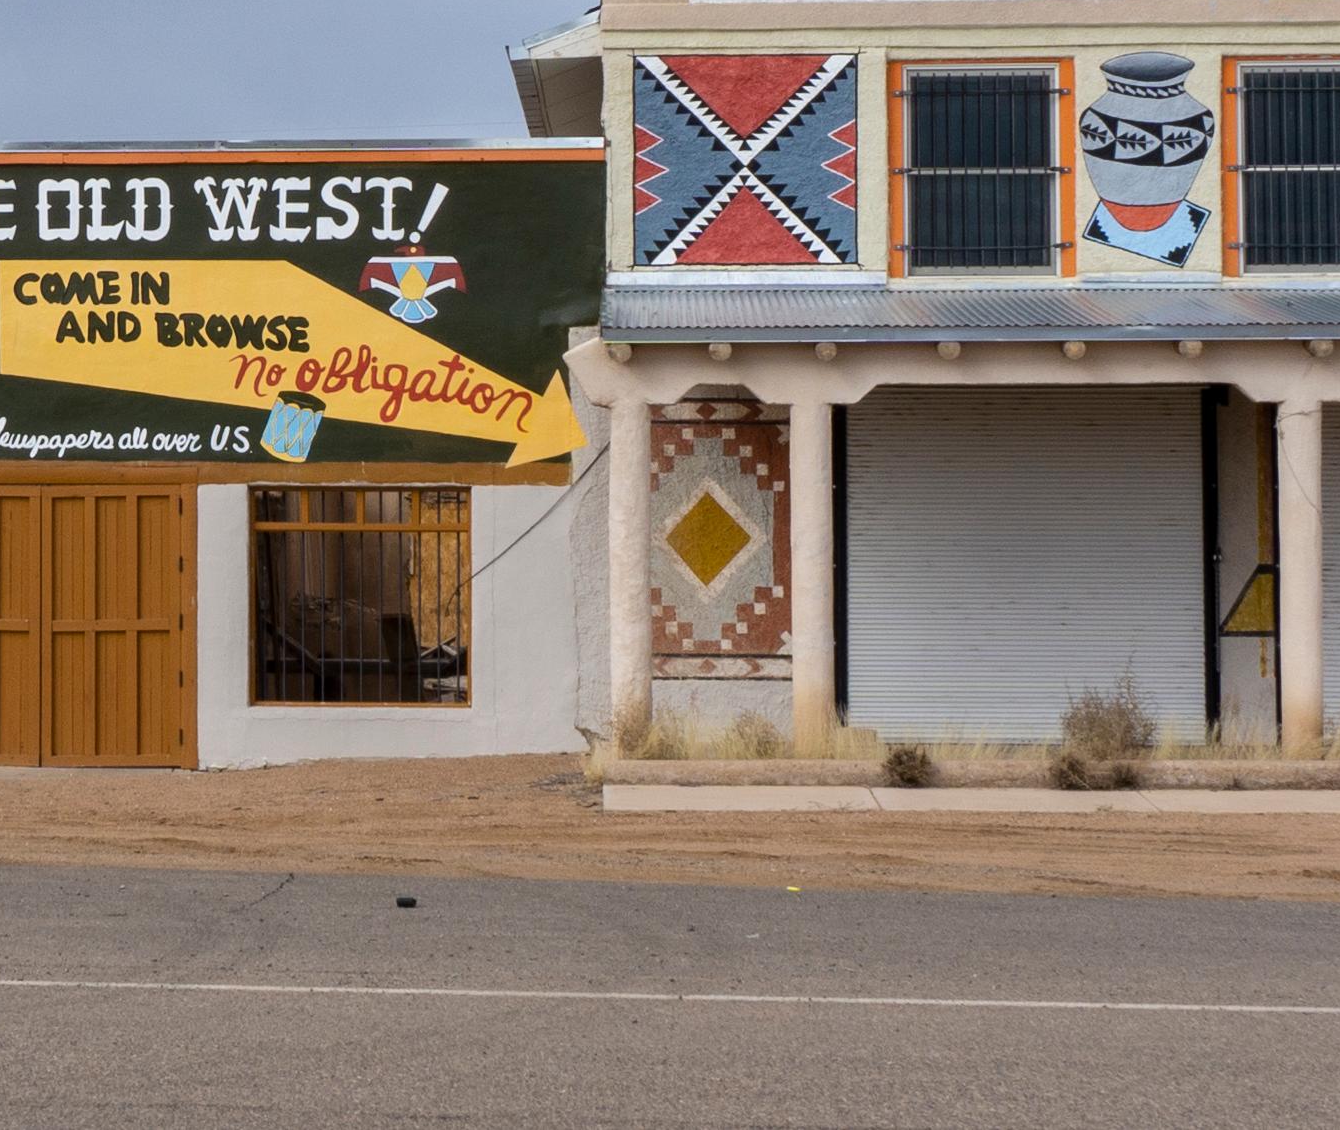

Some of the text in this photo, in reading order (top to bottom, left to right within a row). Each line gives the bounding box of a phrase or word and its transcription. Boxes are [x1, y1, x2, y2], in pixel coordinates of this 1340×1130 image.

[35, 178, 173, 241] OLD
[194, 176, 449, 243] WEST!
[14, 271, 170, 306] COME IN
[55, 311, 310, 353] AND BROWSE
[118, 427, 147, 452] all
[151, 431, 202, 453] over
[210, 425, 253, 454] U.S.
